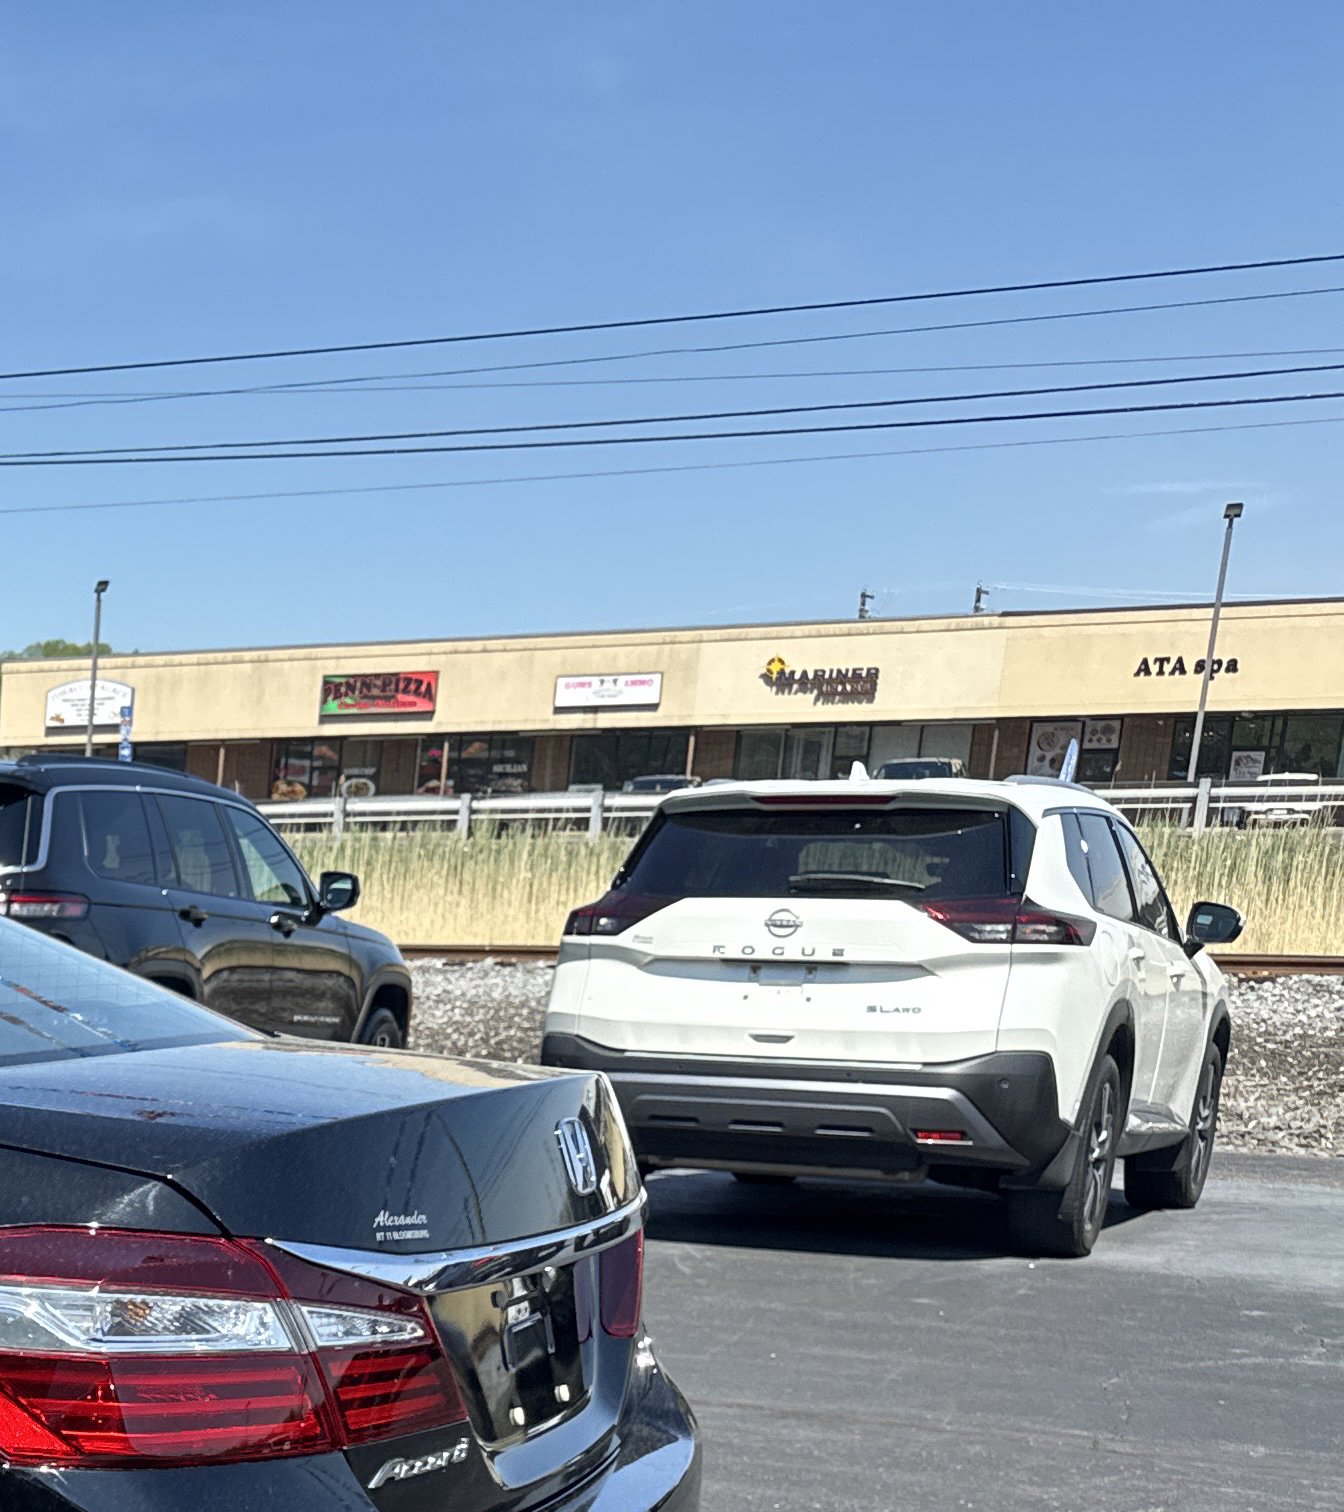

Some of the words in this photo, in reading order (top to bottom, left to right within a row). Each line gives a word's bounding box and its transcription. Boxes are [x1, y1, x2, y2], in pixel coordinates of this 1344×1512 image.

[774, 667, 880, 684] MARINER
[1133, 656, 1187, 677] ATA
[1194, 658, 1239, 680] spa
[712, 944, 845, 957] ROGUE
[373, 1209, 428, 1228] Alexander
